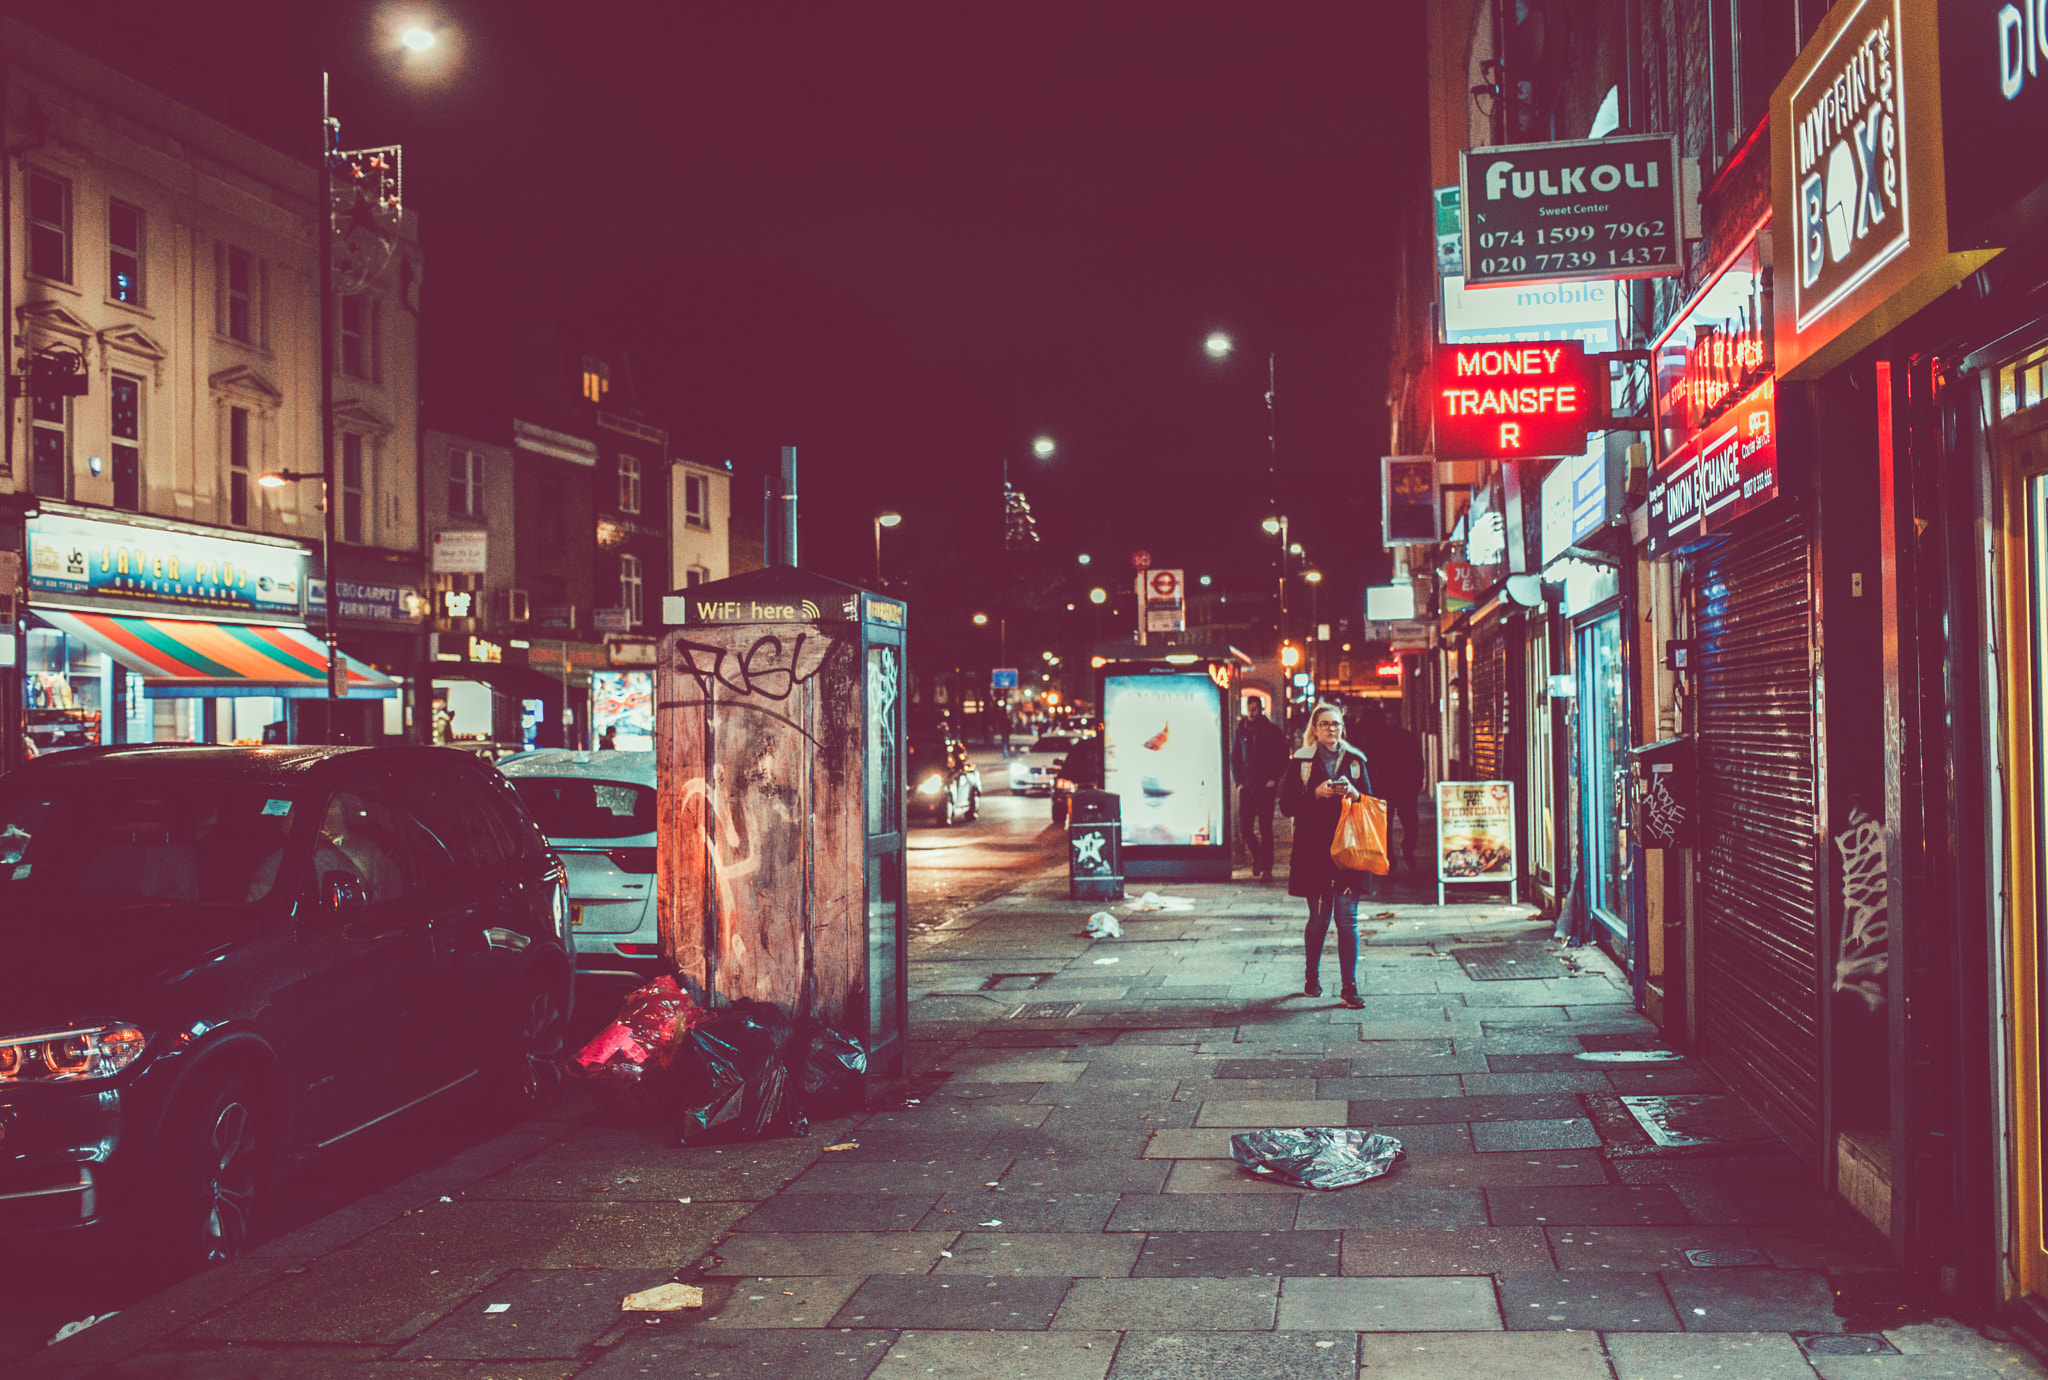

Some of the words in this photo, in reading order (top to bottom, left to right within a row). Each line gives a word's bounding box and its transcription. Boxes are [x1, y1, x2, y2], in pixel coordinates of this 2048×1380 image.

[1800, 27, 1879, 174] MYPRINT
[1485, 160, 1660, 201] FULKOLI
[1539, 206, 1571, 217] Sweet
[1574, 204, 1609, 214] Center
[1479, 230, 1525, 249] 074
[1536, 226, 1595, 245] 1599
[1604, 220, 1665, 240] 7962
[1481, 255, 1526, 274] 020
[1535, 251, 1596, 270] 7739
[1608, 246, 1666, 265] 1437
[1517, 283, 1605, 306] mobile
[1457, 349, 1560, 376] MONEY
[1443, 387, 1575, 415] TRANSFE
[1501, 423, 1519, 448] R
[1667, 474, 1692, 524] UNION
[1693, 440, 1740, 508] EXCHANGE
[101, 544, 180, 581] SAVER
[195, 558, 247, 589] PLUS
[1454, 567, 1471, 581] JU
[336, 582, 356, 598] URO
[357, 586, 396, 602] CARPET
[697, 602, 741, 620] WiFi
[751, 601, 795, 620] here
[1442, 805, 1509, 817] WEDNESDAY
